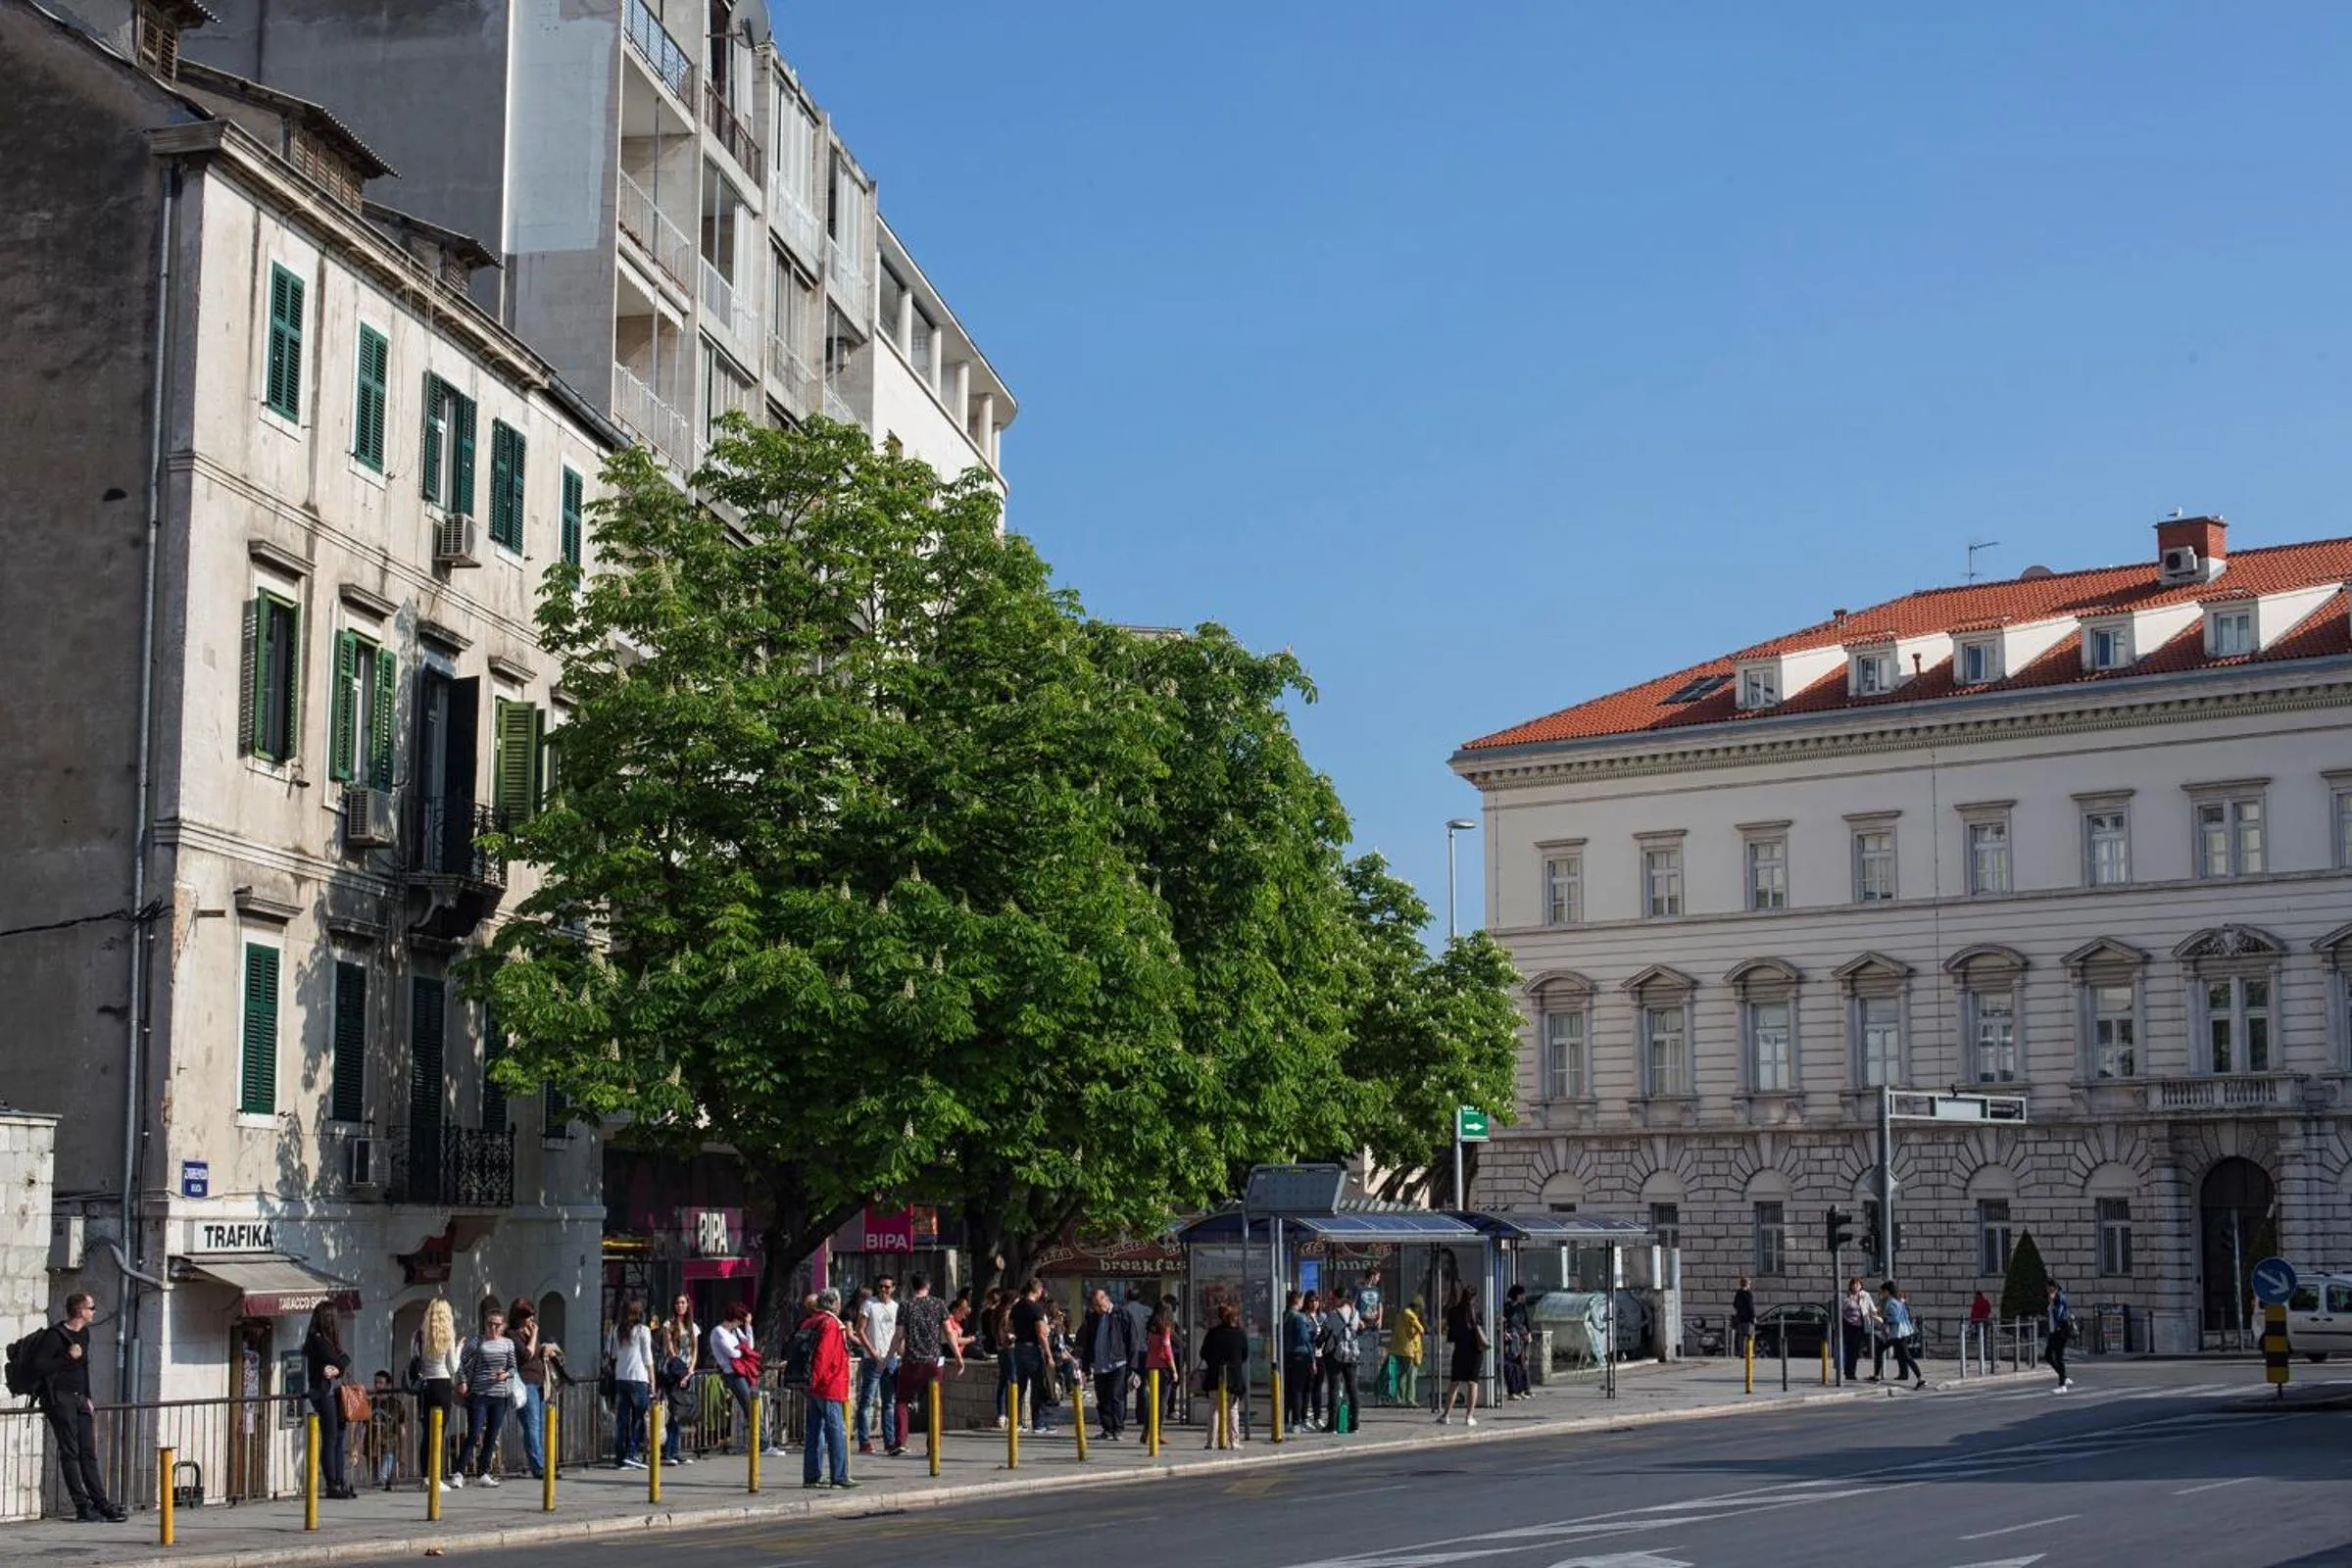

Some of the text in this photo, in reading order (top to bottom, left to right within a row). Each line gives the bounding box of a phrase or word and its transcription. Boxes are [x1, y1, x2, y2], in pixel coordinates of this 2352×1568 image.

[204, 1224, 274, 1249] TRAFIKA
[698, 1212, 728, 1254] BIPA
[865, 1233, 908, 1250] BIPA
